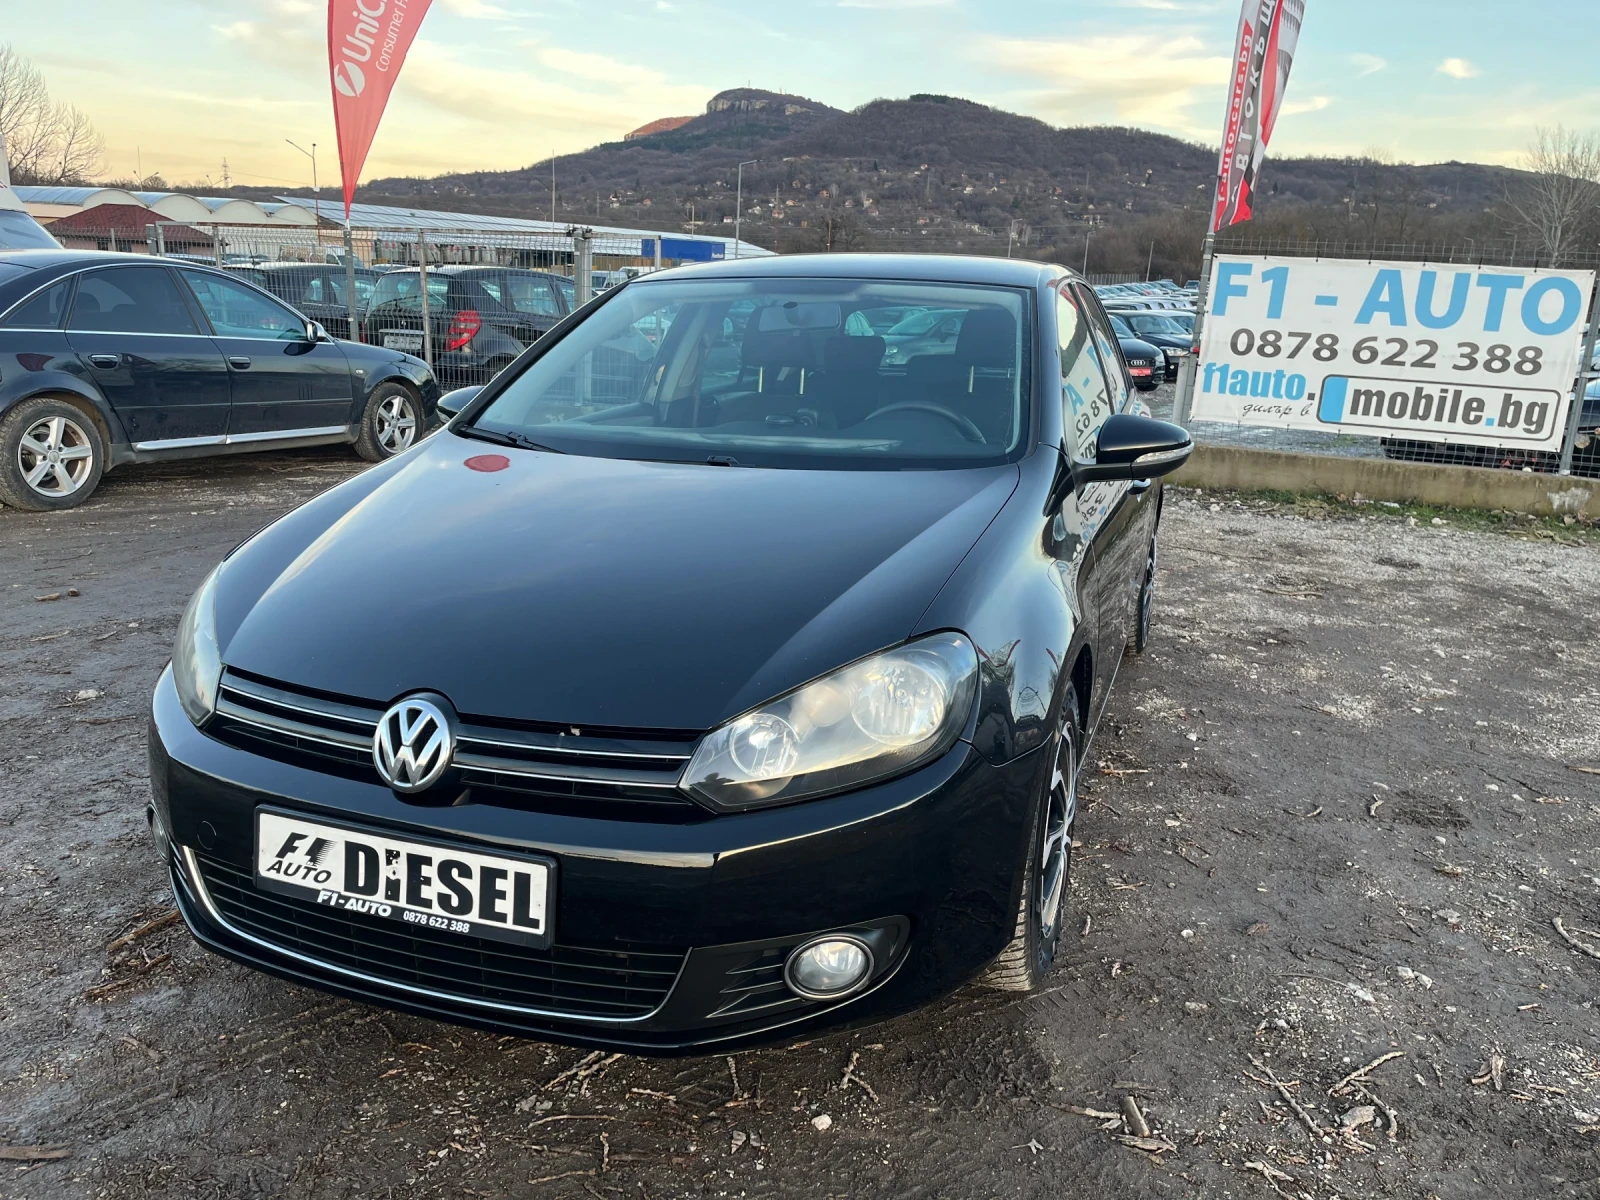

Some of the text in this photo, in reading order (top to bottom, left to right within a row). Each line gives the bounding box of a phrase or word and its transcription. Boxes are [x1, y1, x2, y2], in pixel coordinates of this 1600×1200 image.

[342, 0, 387, 62] UniC
[375, 8, 405, 72] Consumer
[1212, 262, 1289, 319] F1
[1354, 269, 1582, 336] AUTO
[1229, 327, 1543, 376] 0878 622 388
[265, 860, 332, 884] AUTO
[275, 832, 338, 867] F1
[403, 910, 470, 933] 0878 622 388
